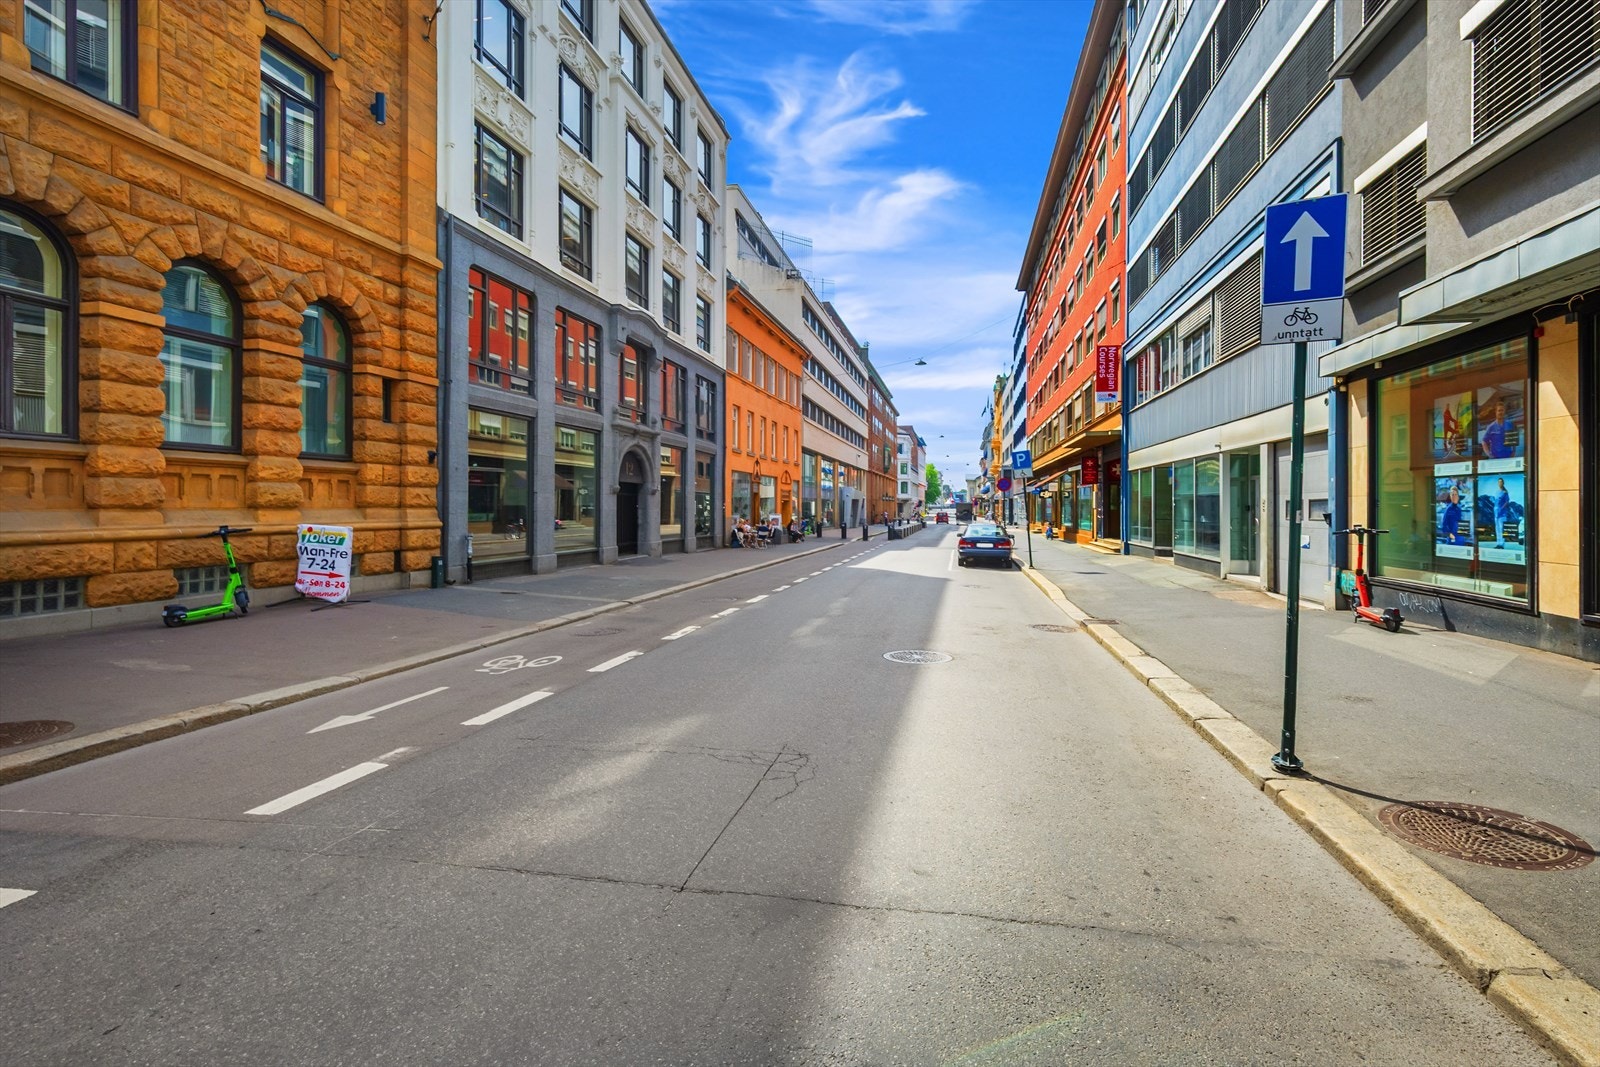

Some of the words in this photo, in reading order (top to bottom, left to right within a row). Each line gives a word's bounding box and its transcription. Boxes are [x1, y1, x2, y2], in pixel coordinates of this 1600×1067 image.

[1277, 327, 1324, 340] unntatt
[1099, 346, 1108, 378] Courses
[1107, 346, 1117, 390] Norwegian
[1015, 453, 1026, 467] P
[625, 462, 634, 476] 12
[299, 545, 348, 559] Man-Fre
[306, 557, 336, 571] 7-24
[325, 580, 346, 589] 8-24
